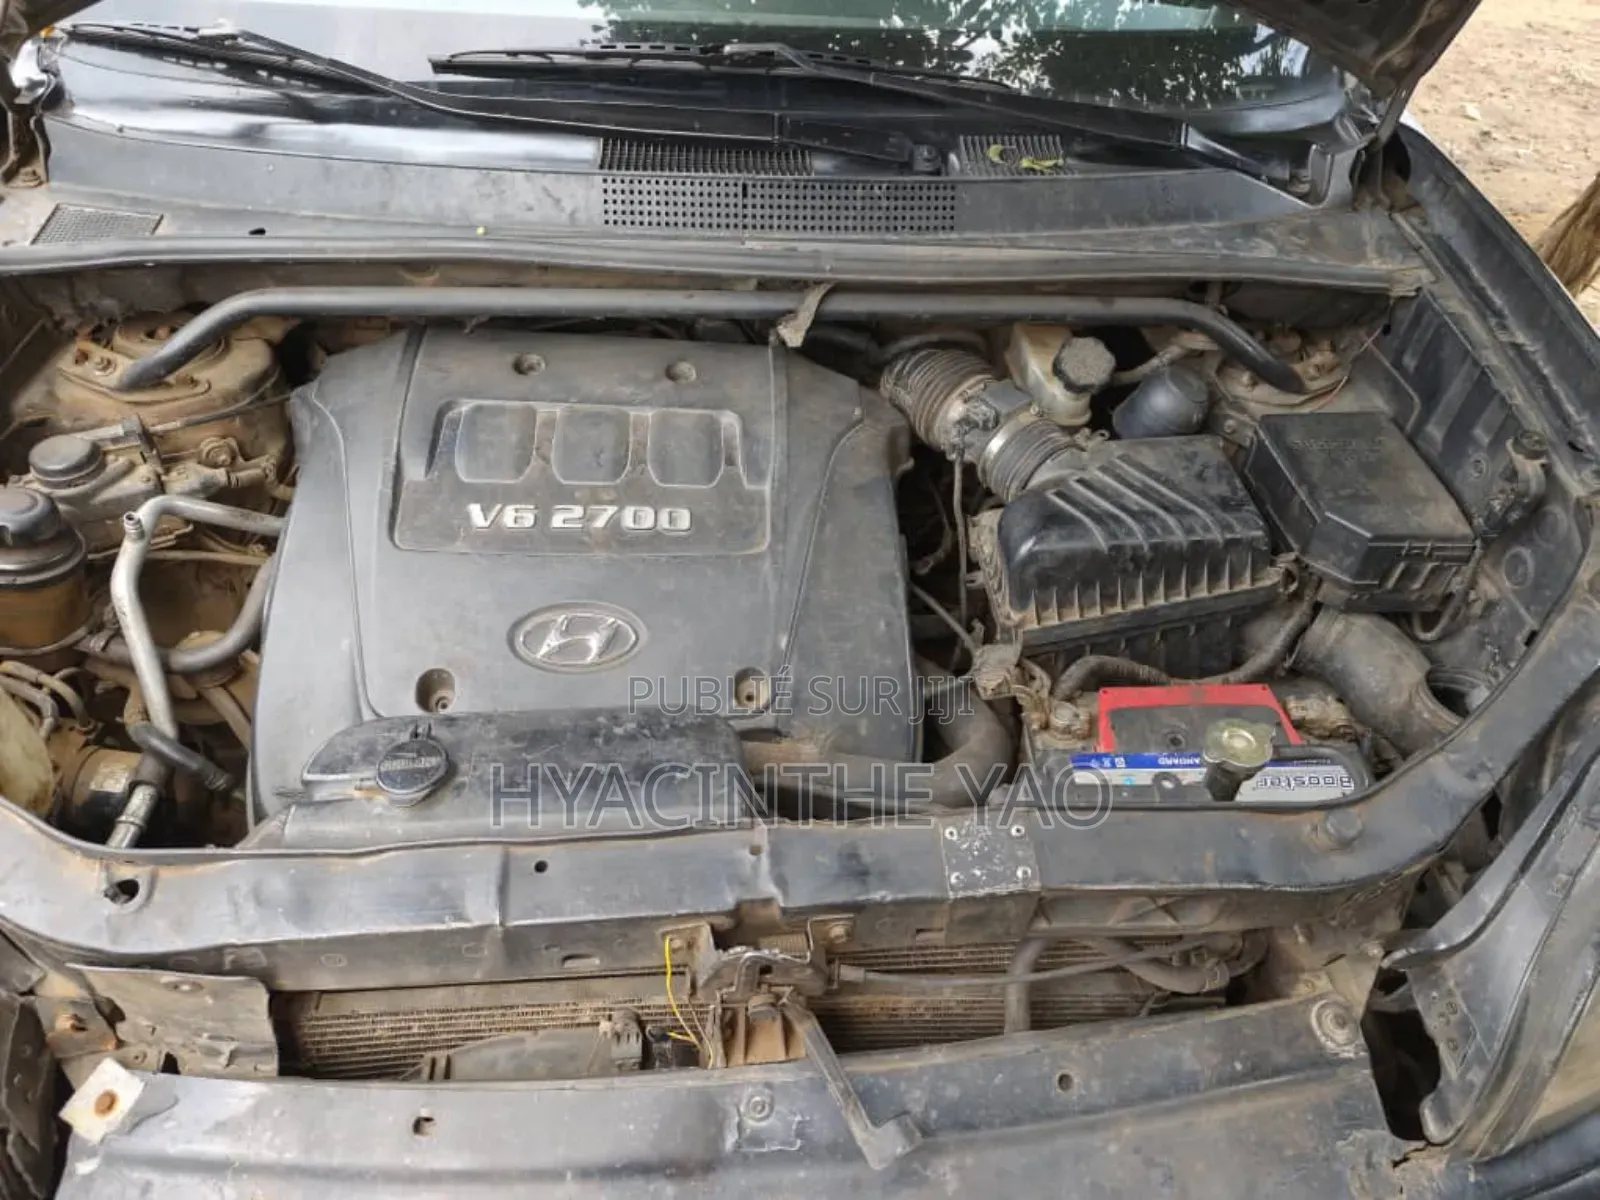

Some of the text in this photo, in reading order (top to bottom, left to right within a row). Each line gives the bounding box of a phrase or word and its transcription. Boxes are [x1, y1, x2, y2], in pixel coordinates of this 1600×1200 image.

[467, 503, 693, 532] V6 2700
[1257, 775, 1355, 791] Booster
